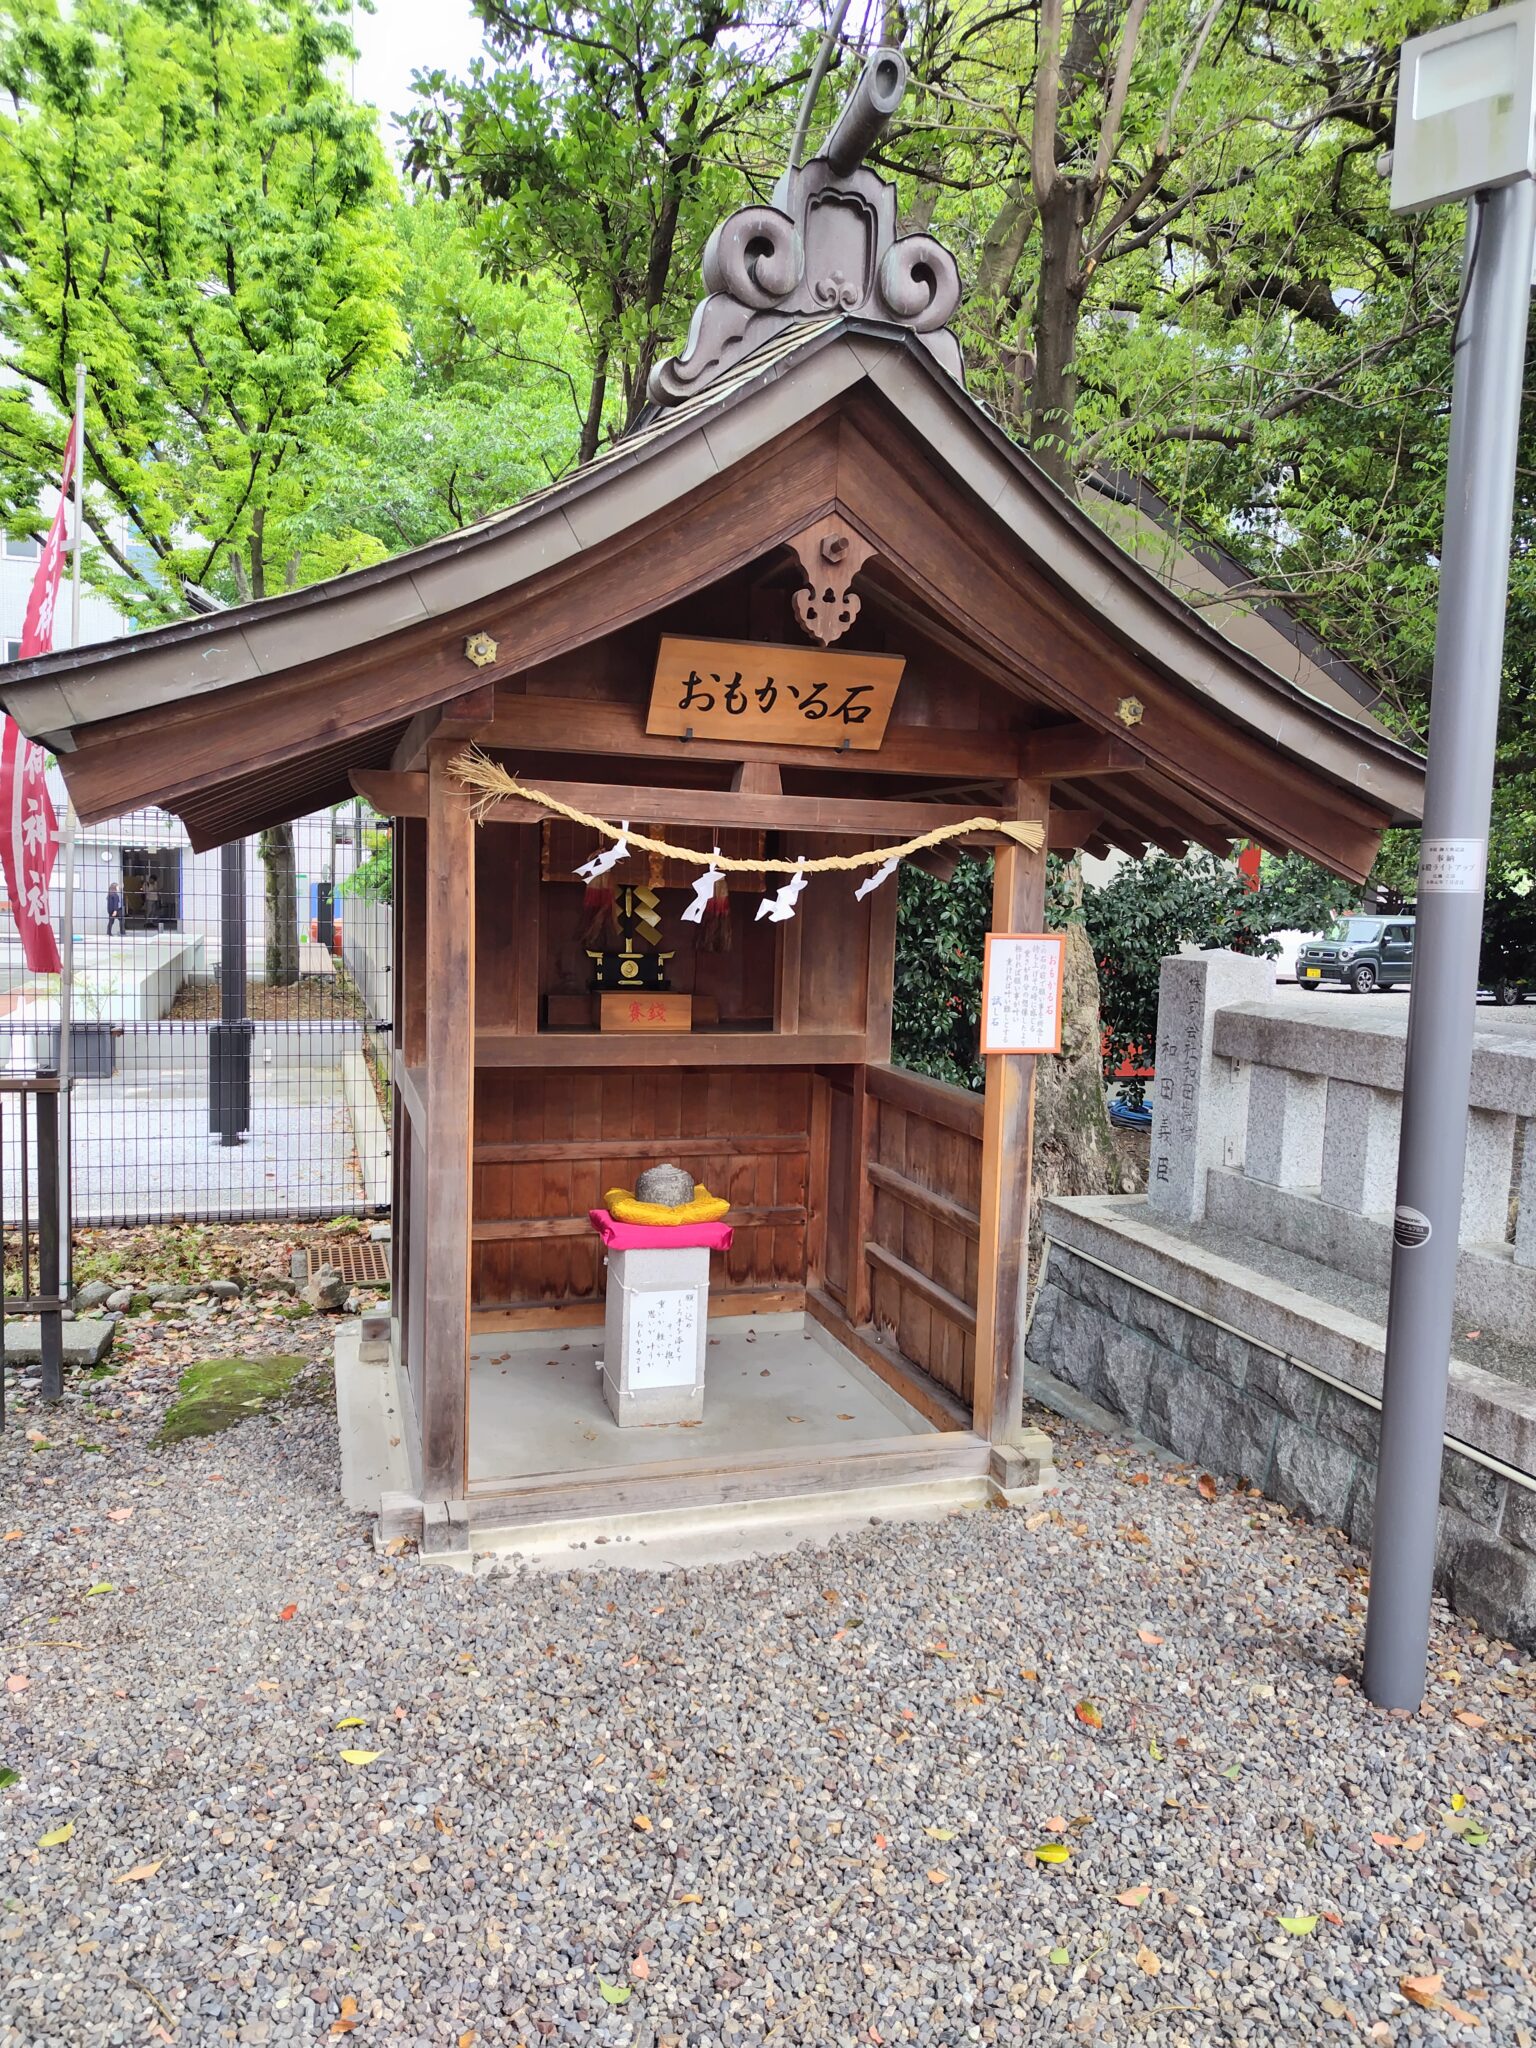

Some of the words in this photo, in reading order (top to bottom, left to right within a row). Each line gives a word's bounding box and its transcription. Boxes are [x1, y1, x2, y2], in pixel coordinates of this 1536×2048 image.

[678, 669, 875, 725] おもかる石
[1046, 955, 1057, 1015] おもかる石
